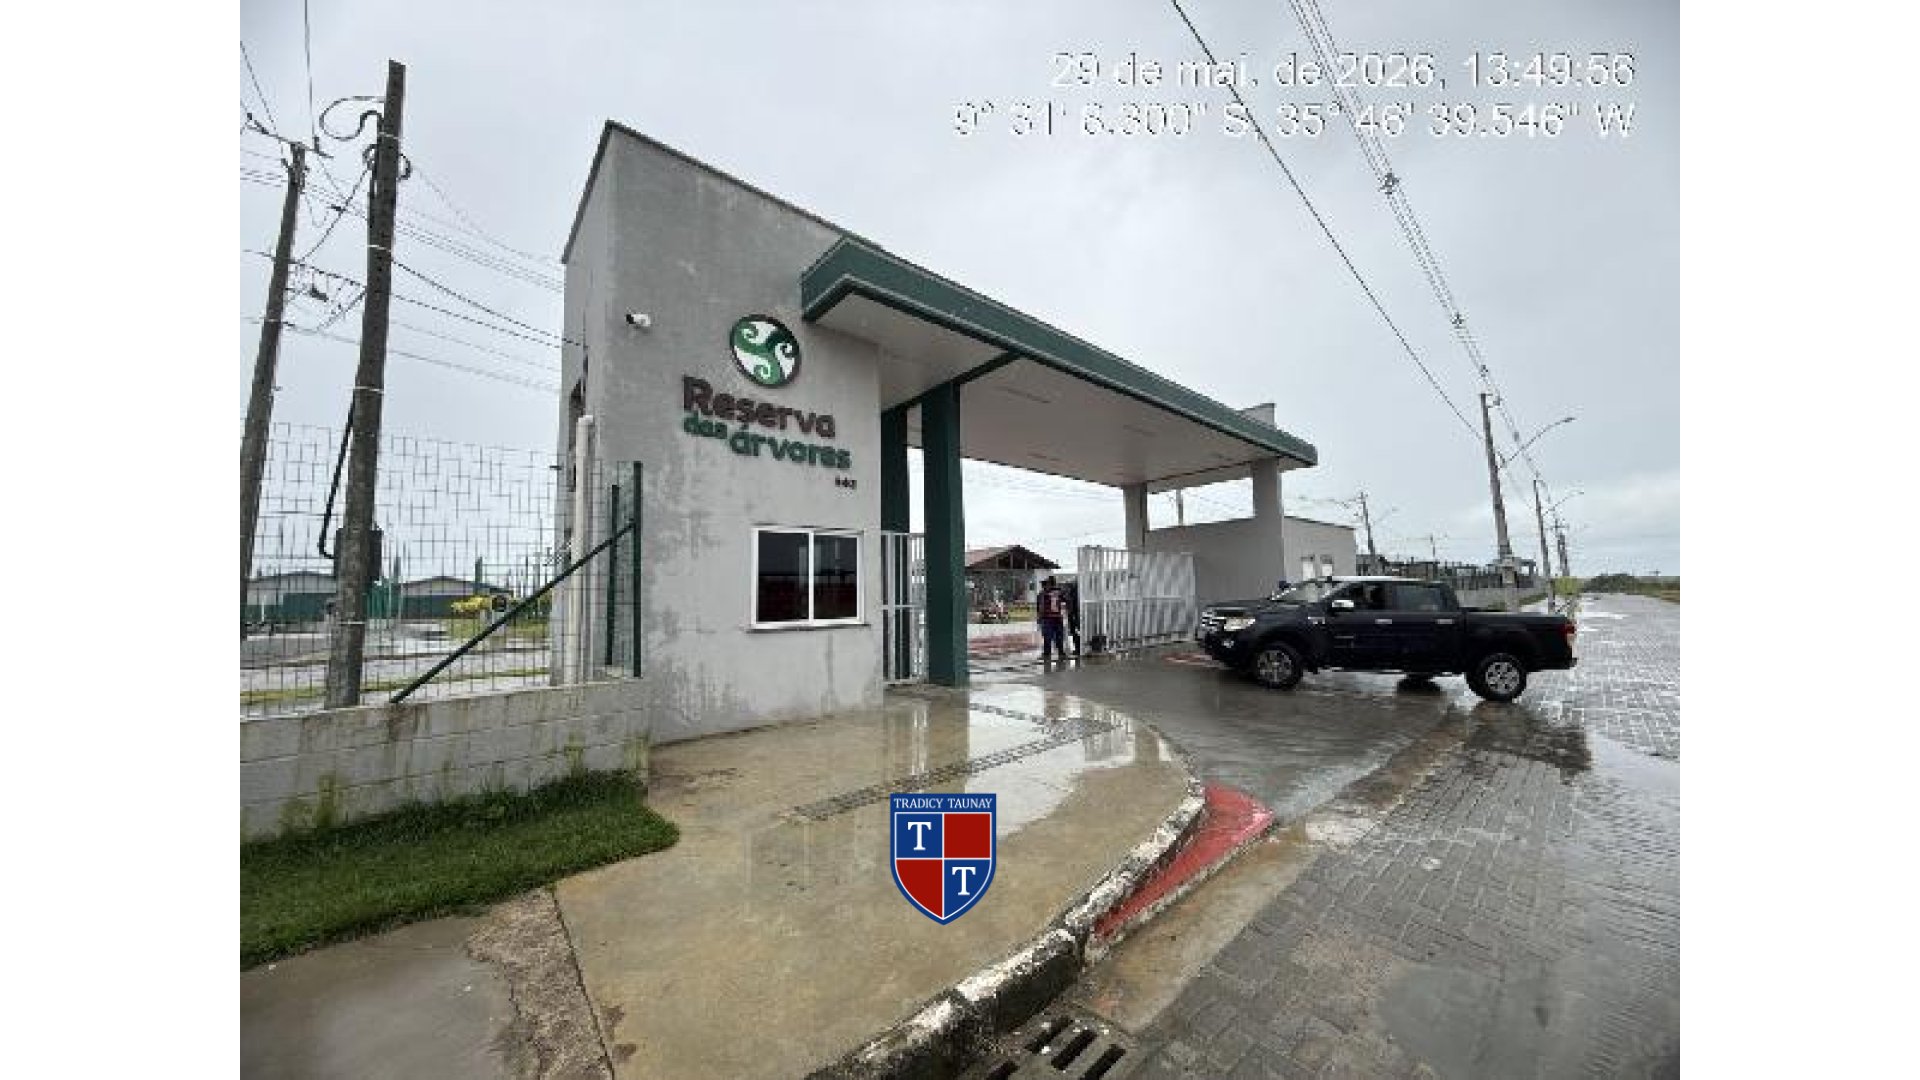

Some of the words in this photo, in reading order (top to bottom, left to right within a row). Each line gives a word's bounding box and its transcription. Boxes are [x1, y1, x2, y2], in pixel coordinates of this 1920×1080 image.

[683, 375, 836, 439] Reserva
[683, 413, 728, 440] das
[729, 423, 852, 469] árvores
